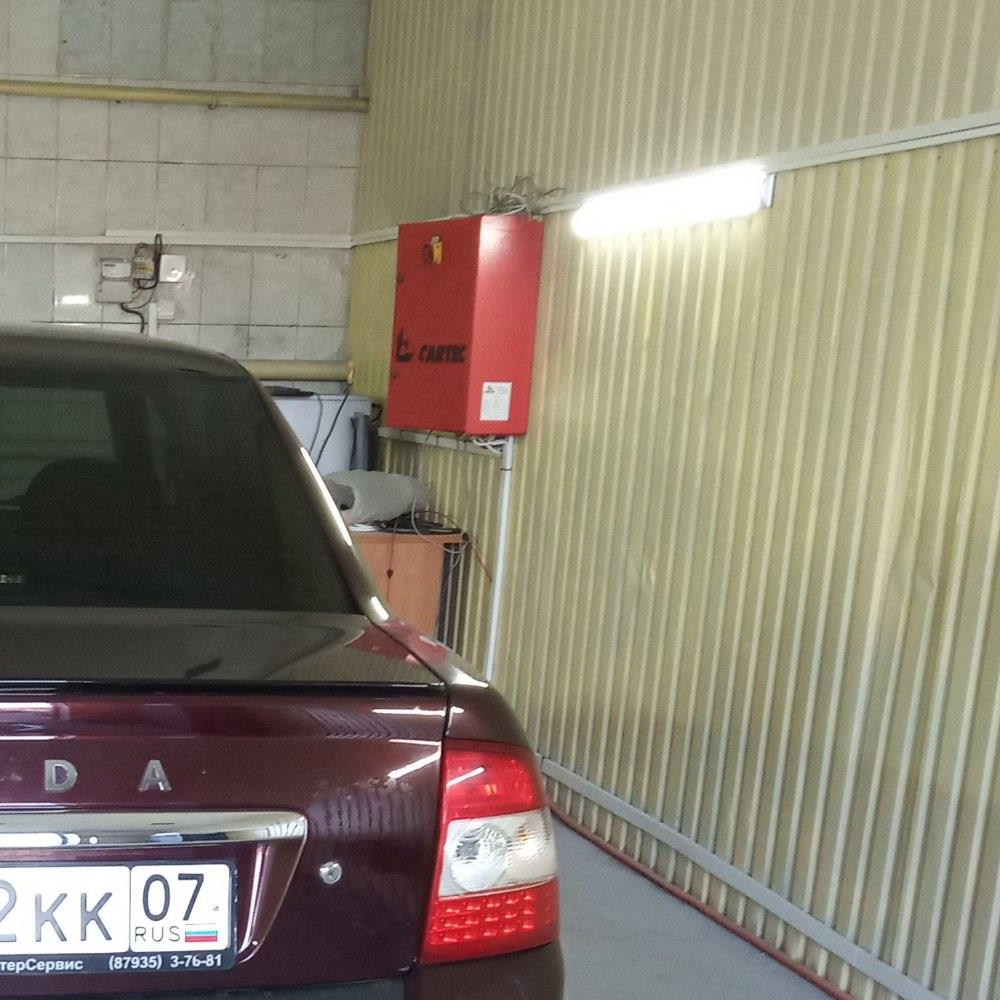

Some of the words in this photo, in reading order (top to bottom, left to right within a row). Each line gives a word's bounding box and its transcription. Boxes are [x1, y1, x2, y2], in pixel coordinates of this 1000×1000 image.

[142, 873, 205, 921] 07
[135, 927, 180, 943] RUS
[108, 955, 163, 970] (87935)
[170, 953, 222, 968] 3-76-81
